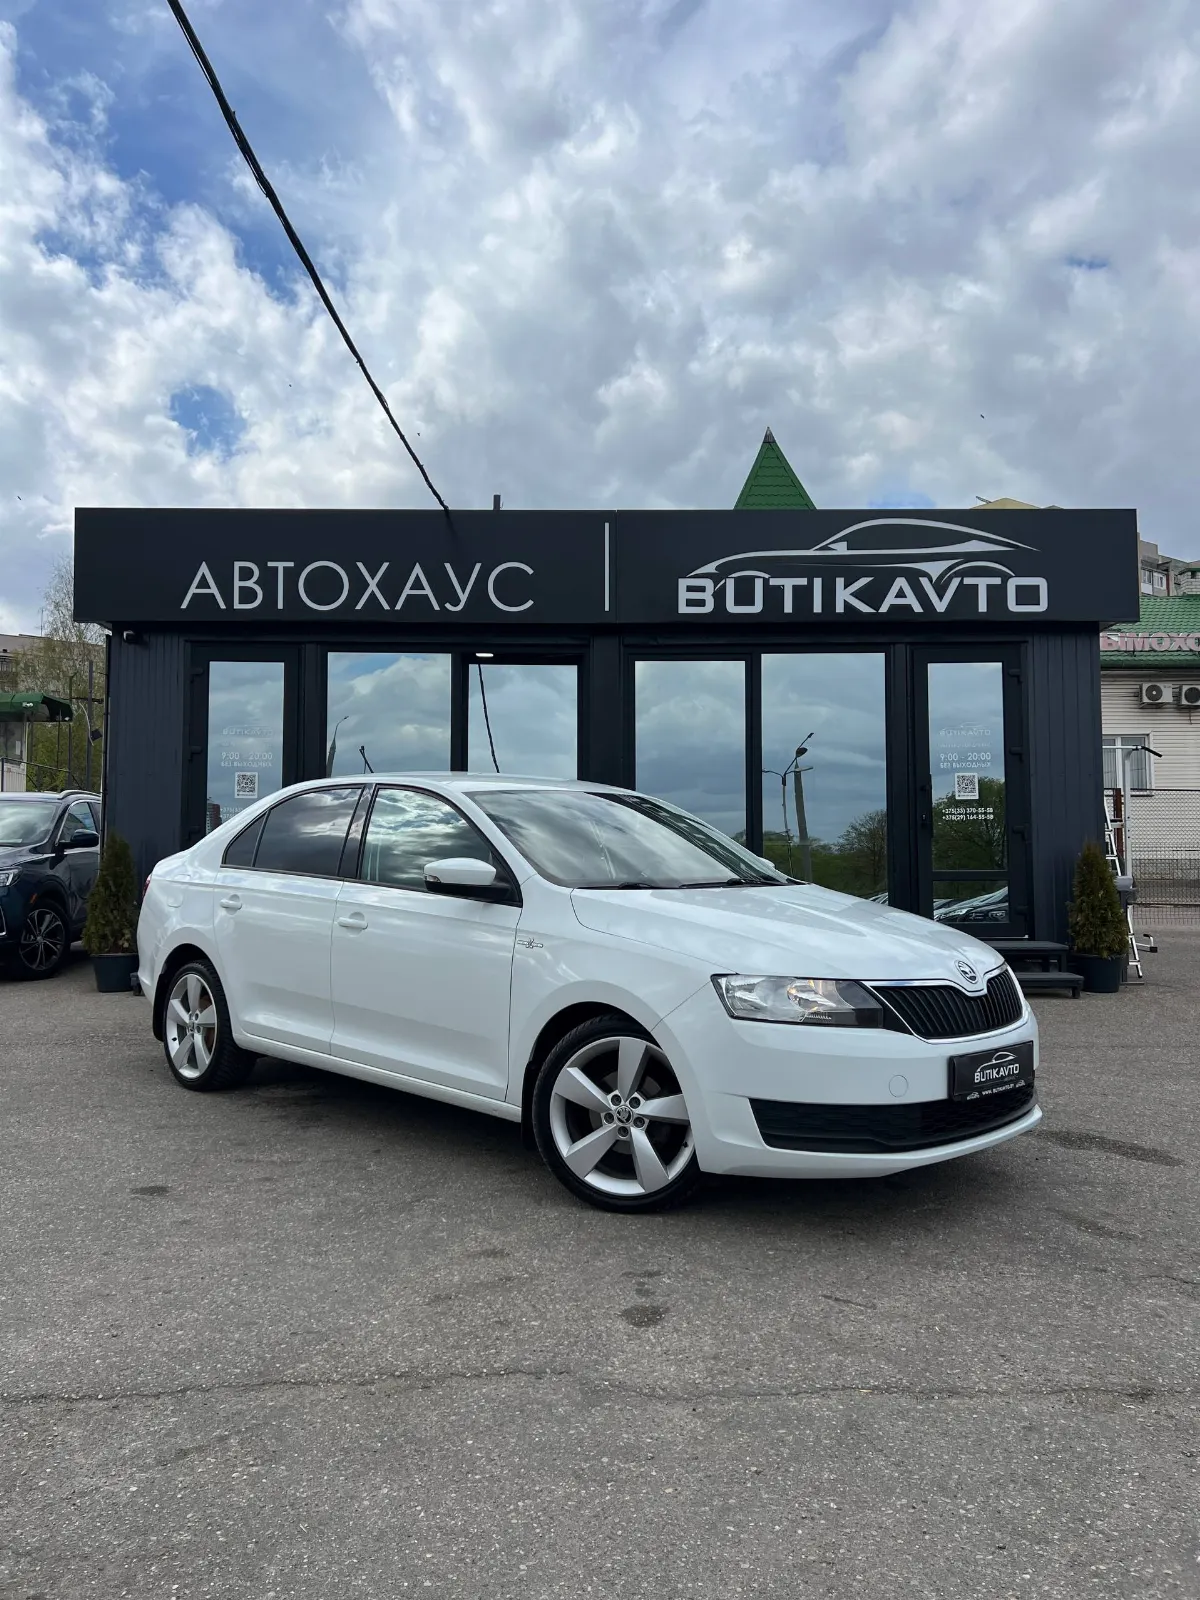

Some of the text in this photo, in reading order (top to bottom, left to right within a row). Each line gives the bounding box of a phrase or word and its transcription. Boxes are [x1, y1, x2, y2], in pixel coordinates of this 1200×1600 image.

[181, 561, 534, 611] АВТОХАУС
[677, 577, 1049, 614] BUTIKAVTO
[939, 728, 991, 736] BUTIKAVTO
[221, 752, 273, 760] 9:00 20:00
[940, 752, 958, 761] 9:00
[967, 752, 991, 760] 20:00
[974, 1064, 1020, 1083] BUTIKAVTO
